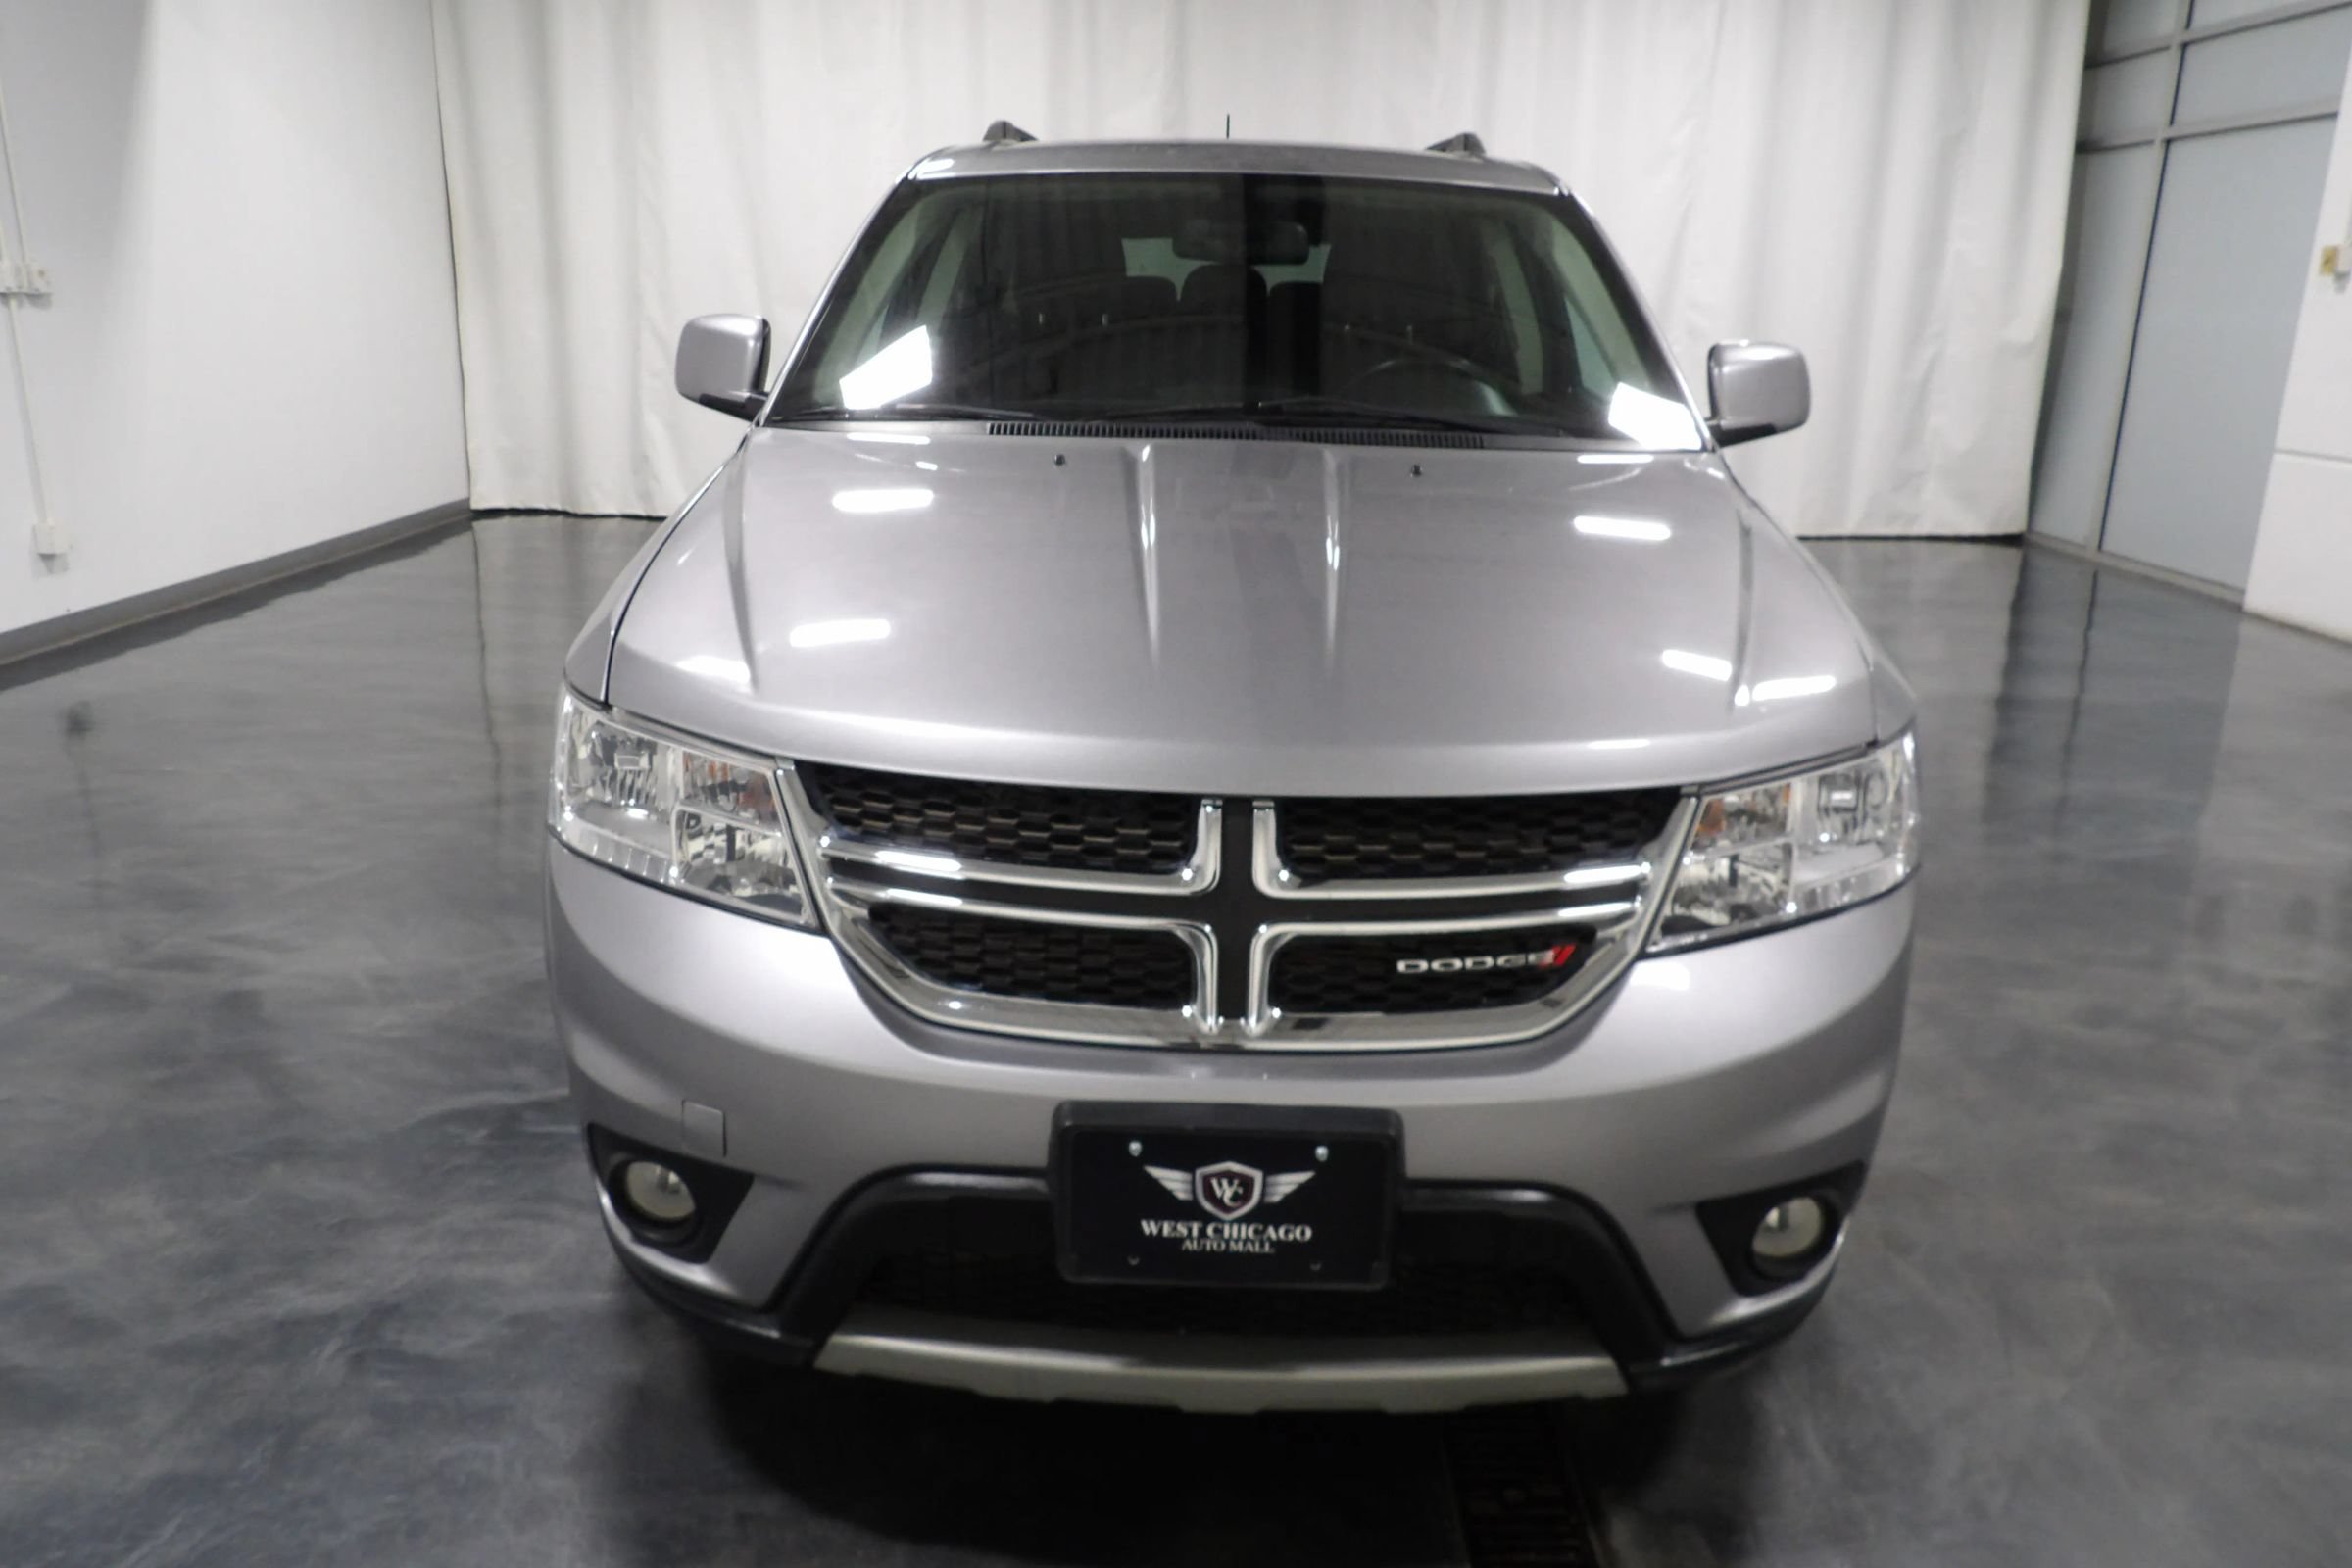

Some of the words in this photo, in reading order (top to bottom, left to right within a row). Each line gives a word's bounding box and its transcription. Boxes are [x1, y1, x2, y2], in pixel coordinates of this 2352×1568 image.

[1397, 950, 1554, 973] DODGE
[1141, 1219, 1203, 1238] WEST
[1207, 1222, 1313, 1242] CHICAGO
[1182, 1239, 1225, 1252] AUTO
[1228, 1241, 1274, 1254] MALL
